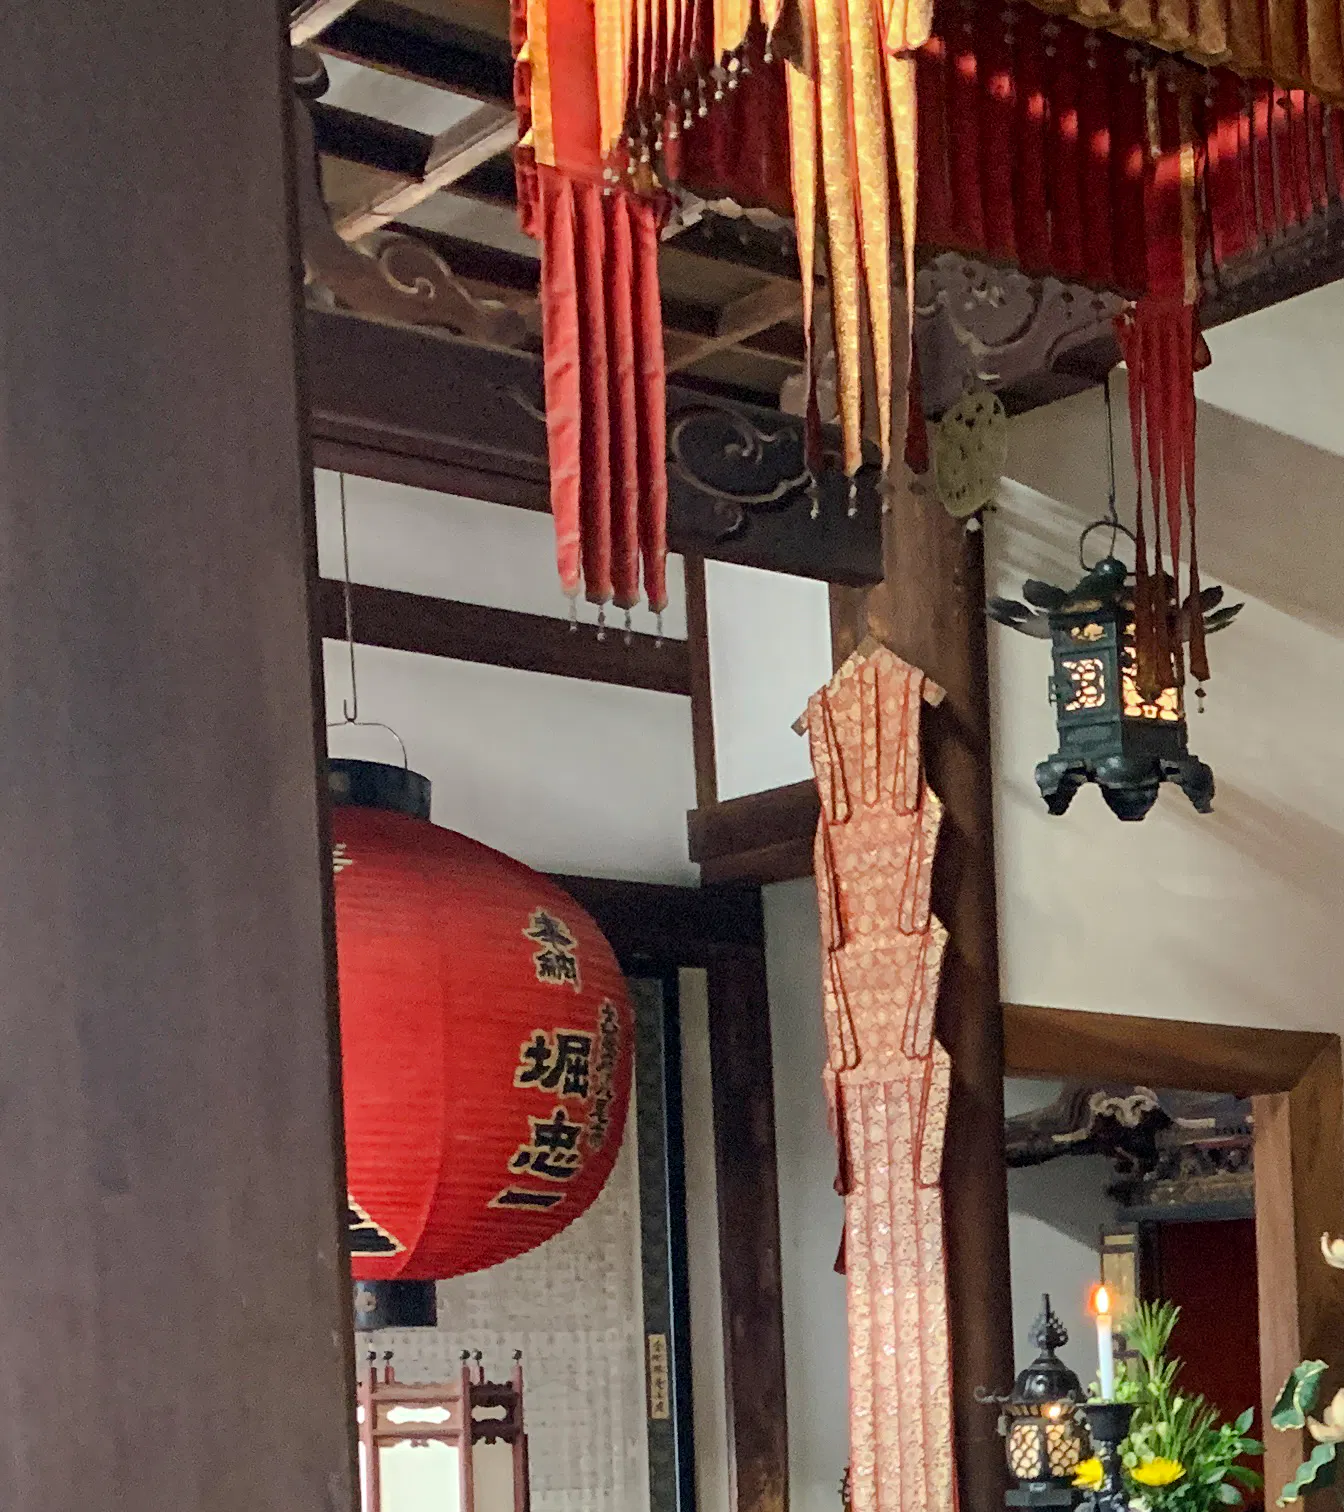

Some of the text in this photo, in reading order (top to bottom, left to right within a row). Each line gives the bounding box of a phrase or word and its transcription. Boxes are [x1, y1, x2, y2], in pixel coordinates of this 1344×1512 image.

[524, 909, 580, 988] 奉納
[492, 1031, 593, 1206] 堀忠一
